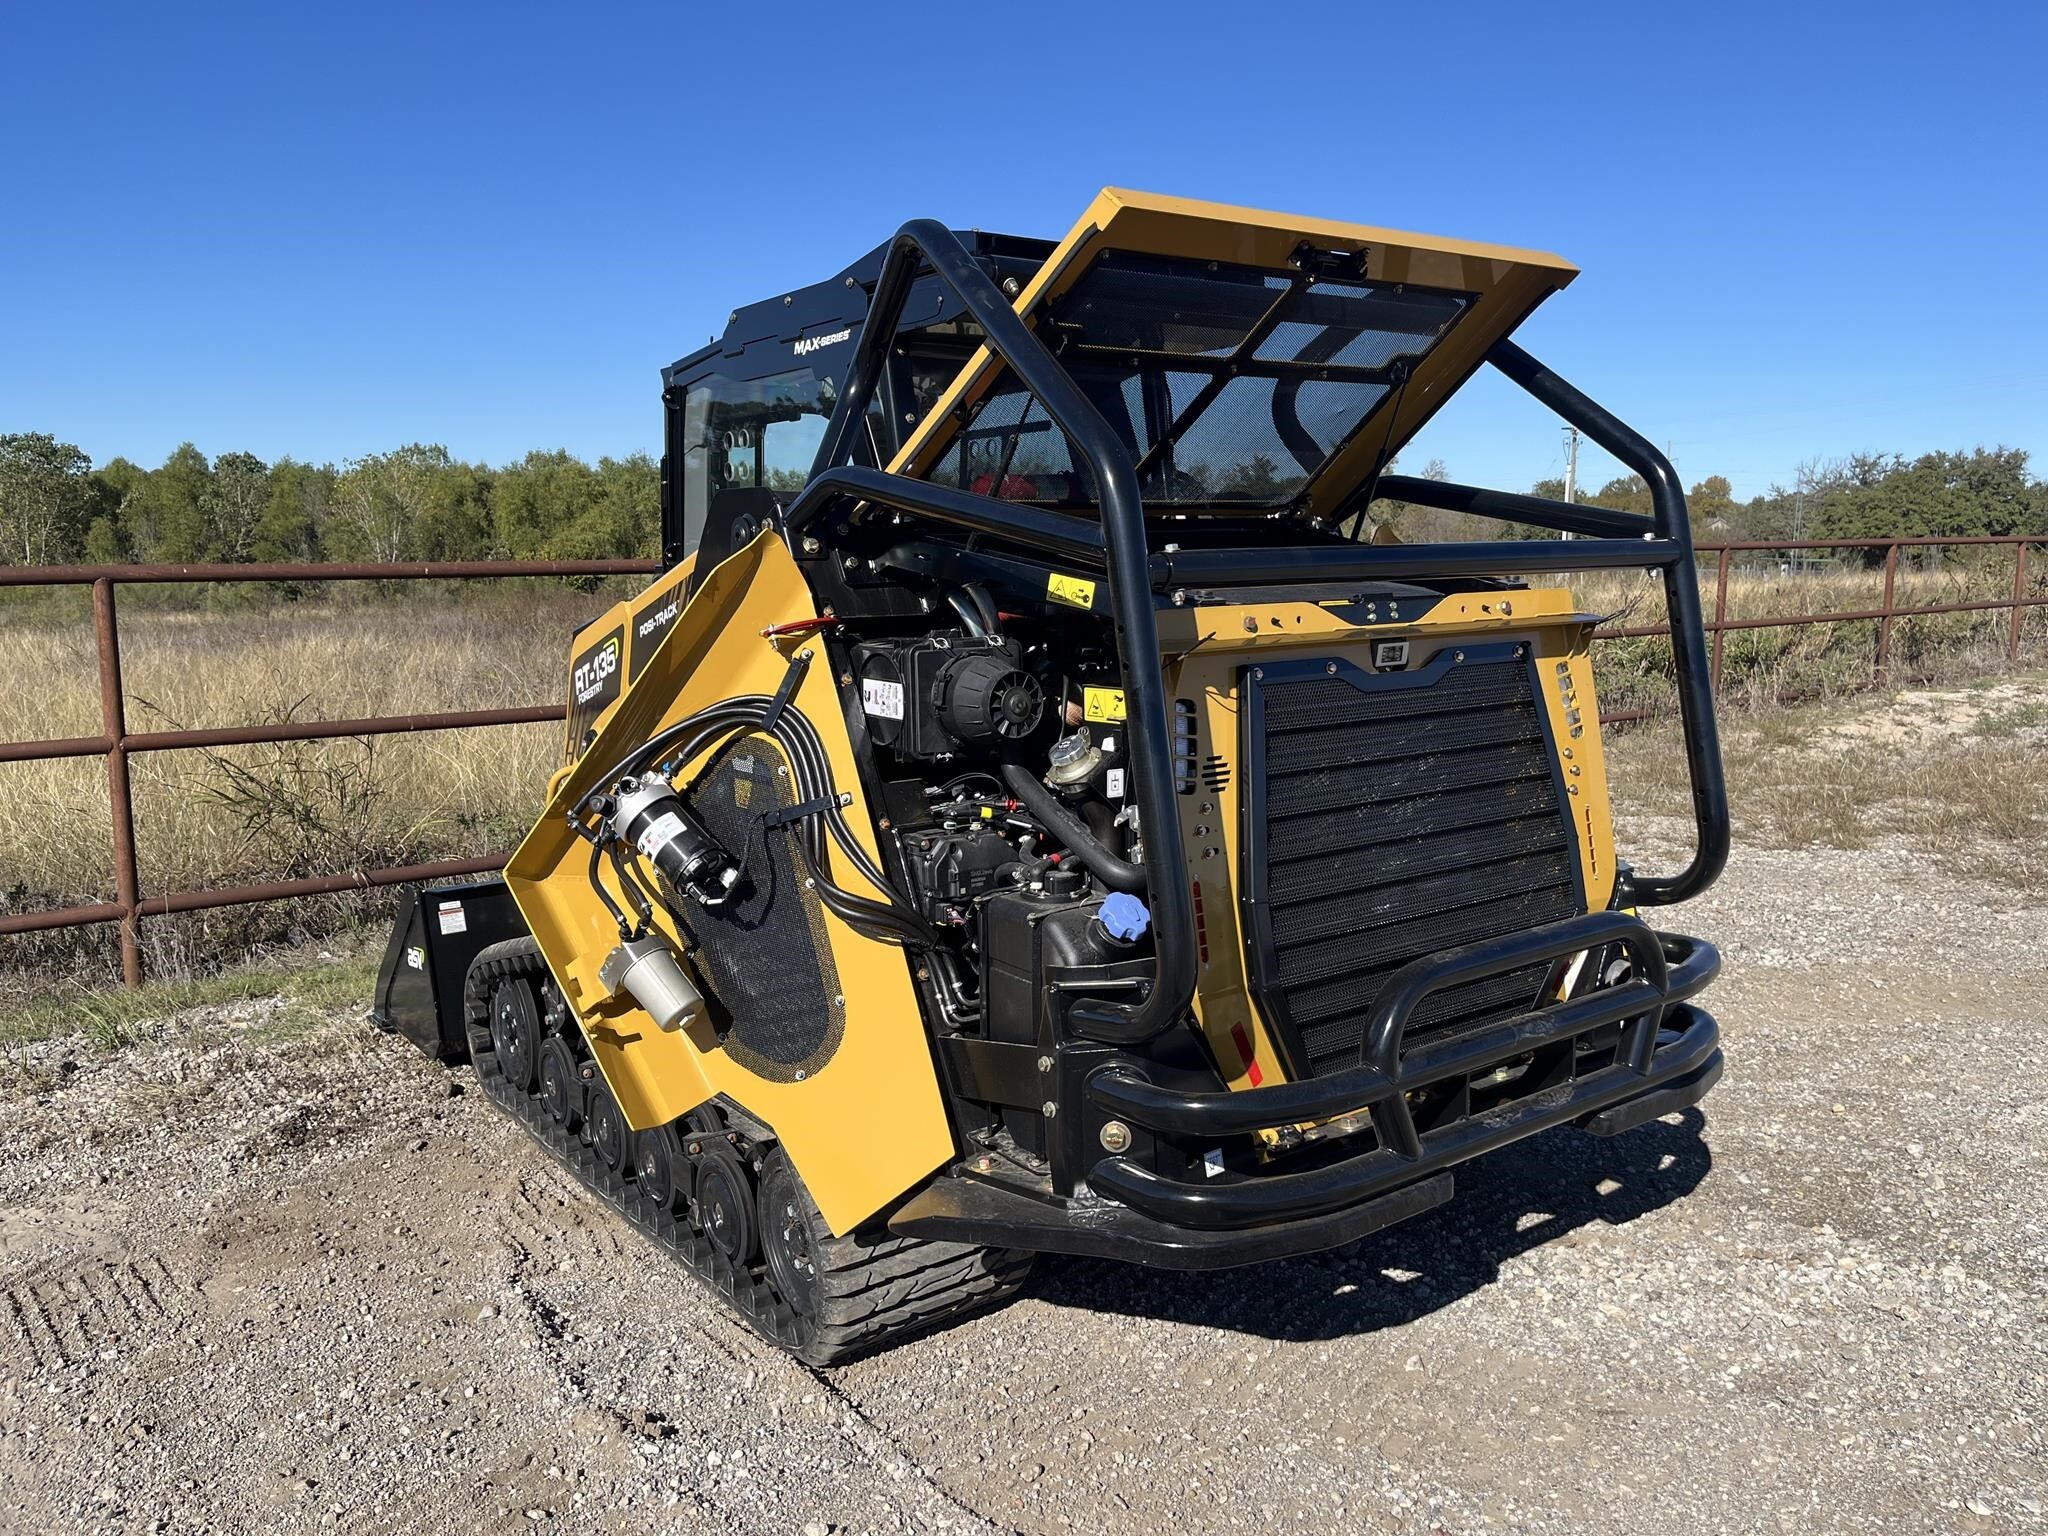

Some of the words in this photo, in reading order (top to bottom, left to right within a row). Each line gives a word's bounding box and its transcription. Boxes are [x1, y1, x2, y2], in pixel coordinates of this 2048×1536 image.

[794, 330, 850, 355] MAX-SERIES
[639, 602, 678, 638] POSI-TRACK
[575, 645, 616, 696] RT-135
[578, 680, 603, 705] FORESTRY
